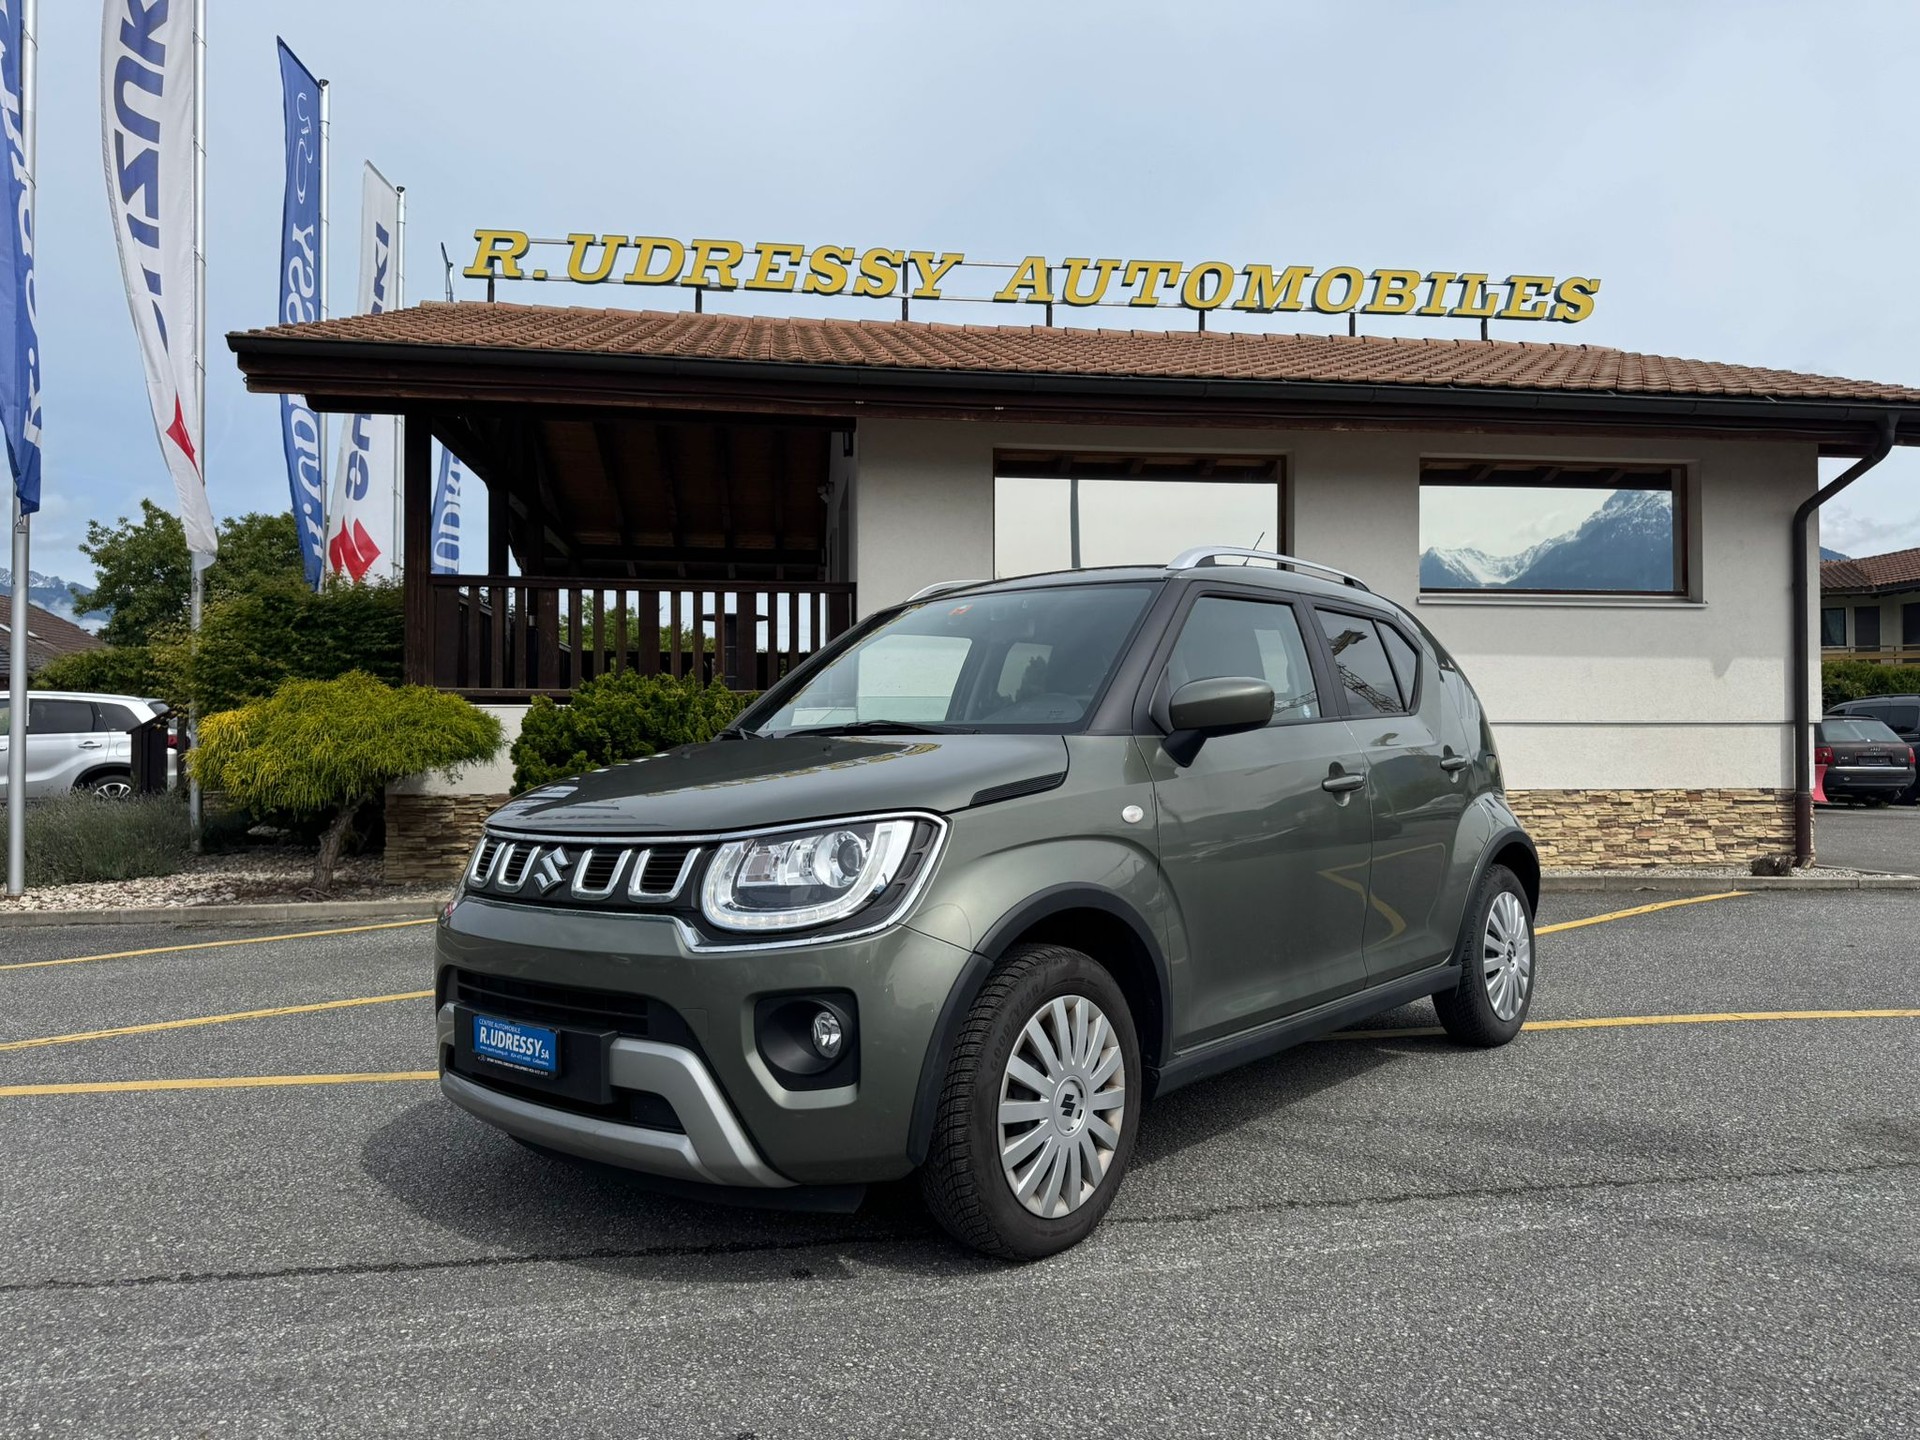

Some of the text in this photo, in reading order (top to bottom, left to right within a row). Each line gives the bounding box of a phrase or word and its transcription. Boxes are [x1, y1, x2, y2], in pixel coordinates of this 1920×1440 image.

[993, 255, 1603, 324] AUTOMOBILES
[480, 1026, 542, 1057] R.UDRESSY
[541, 1048, 550, 1060] SA
